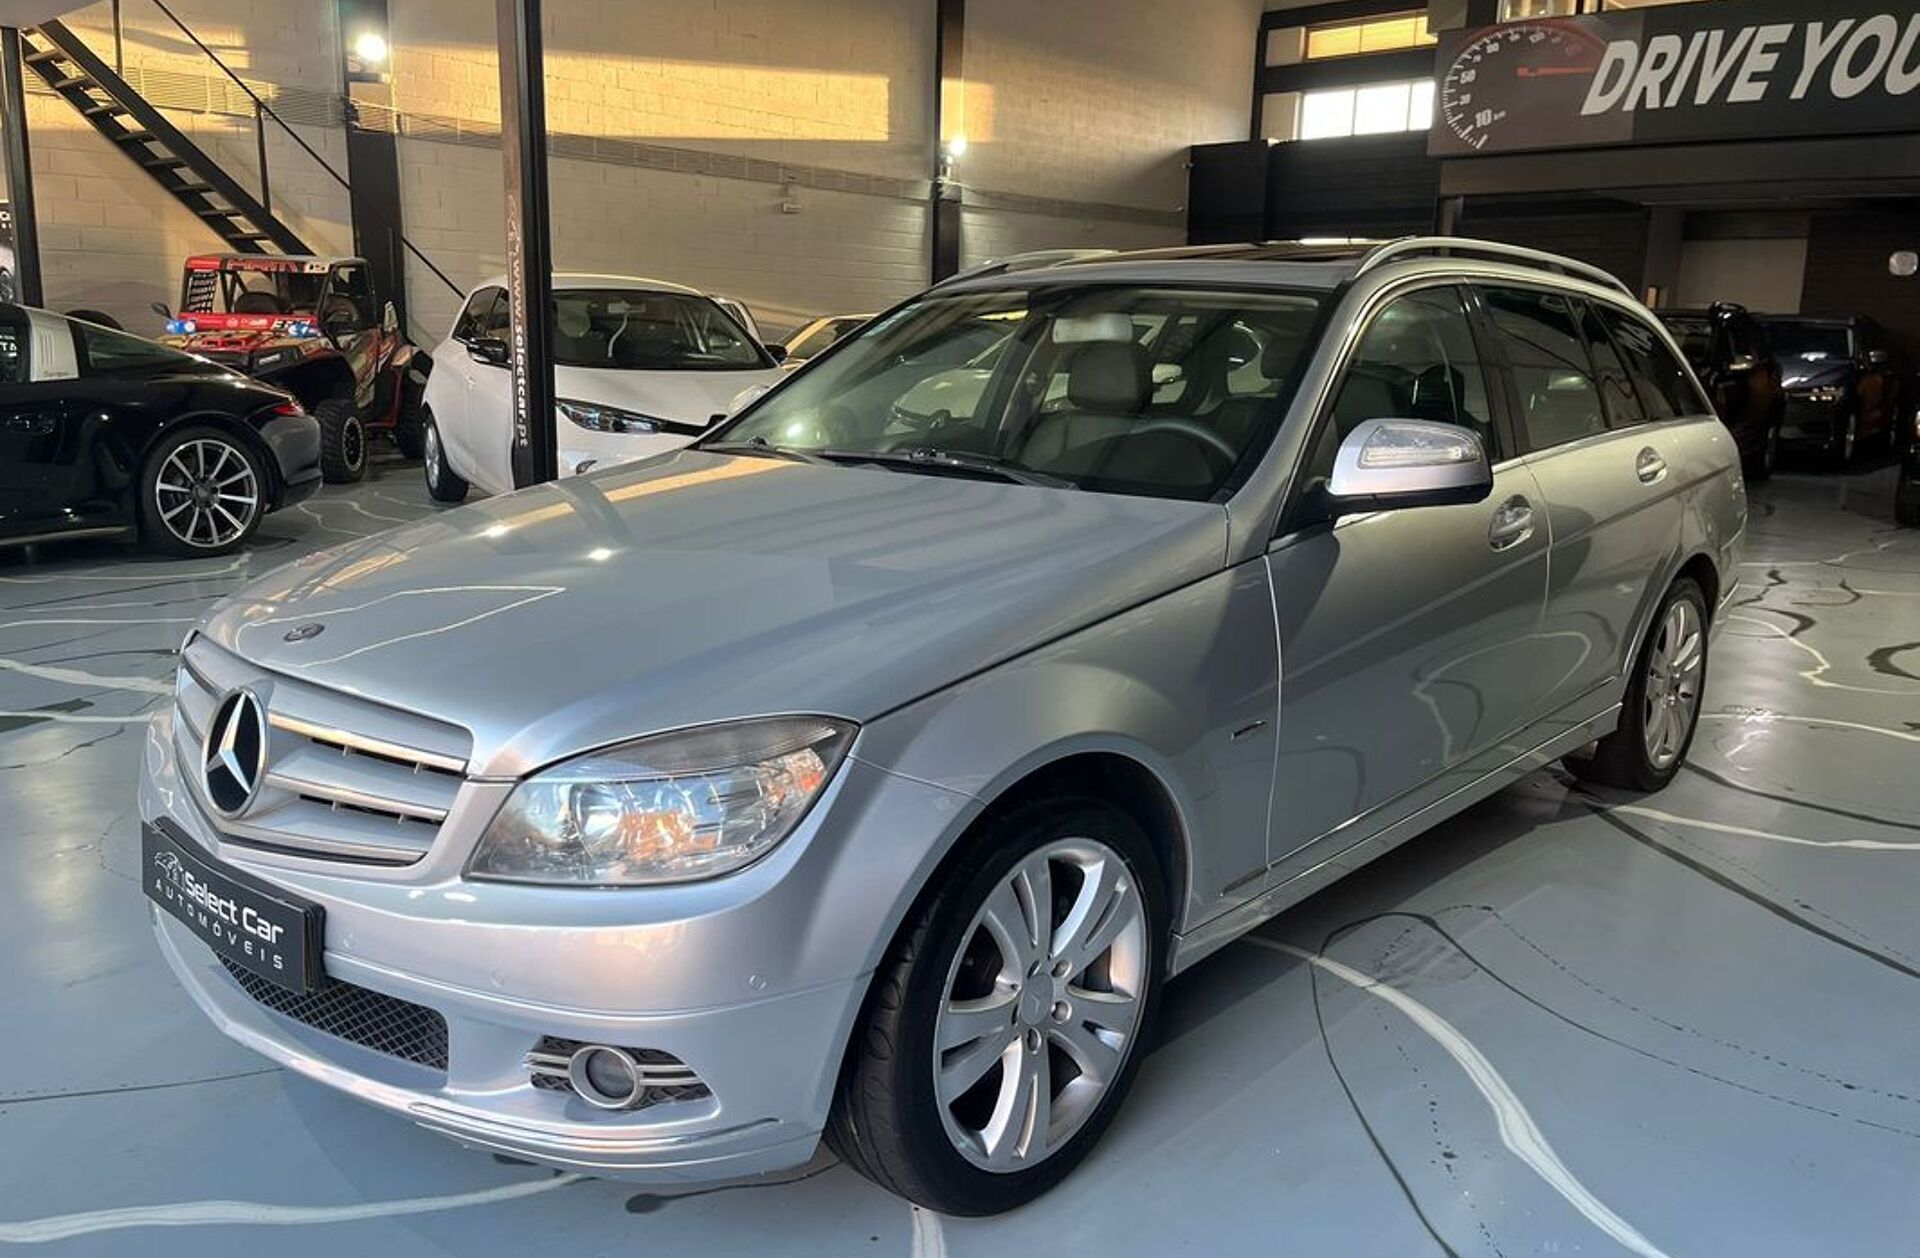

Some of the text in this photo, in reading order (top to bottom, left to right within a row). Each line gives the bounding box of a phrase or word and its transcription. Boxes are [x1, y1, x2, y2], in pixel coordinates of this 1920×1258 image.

[1581, 23, 1790, 116] DRIVE
[1475, 109, 1492, 128] 10
[512, 261, 528, 447] www.selectcar.pt
[154, 879, 284, 970] AUTOMÓVEIS
[185, 870, 284, 944] Select Car
